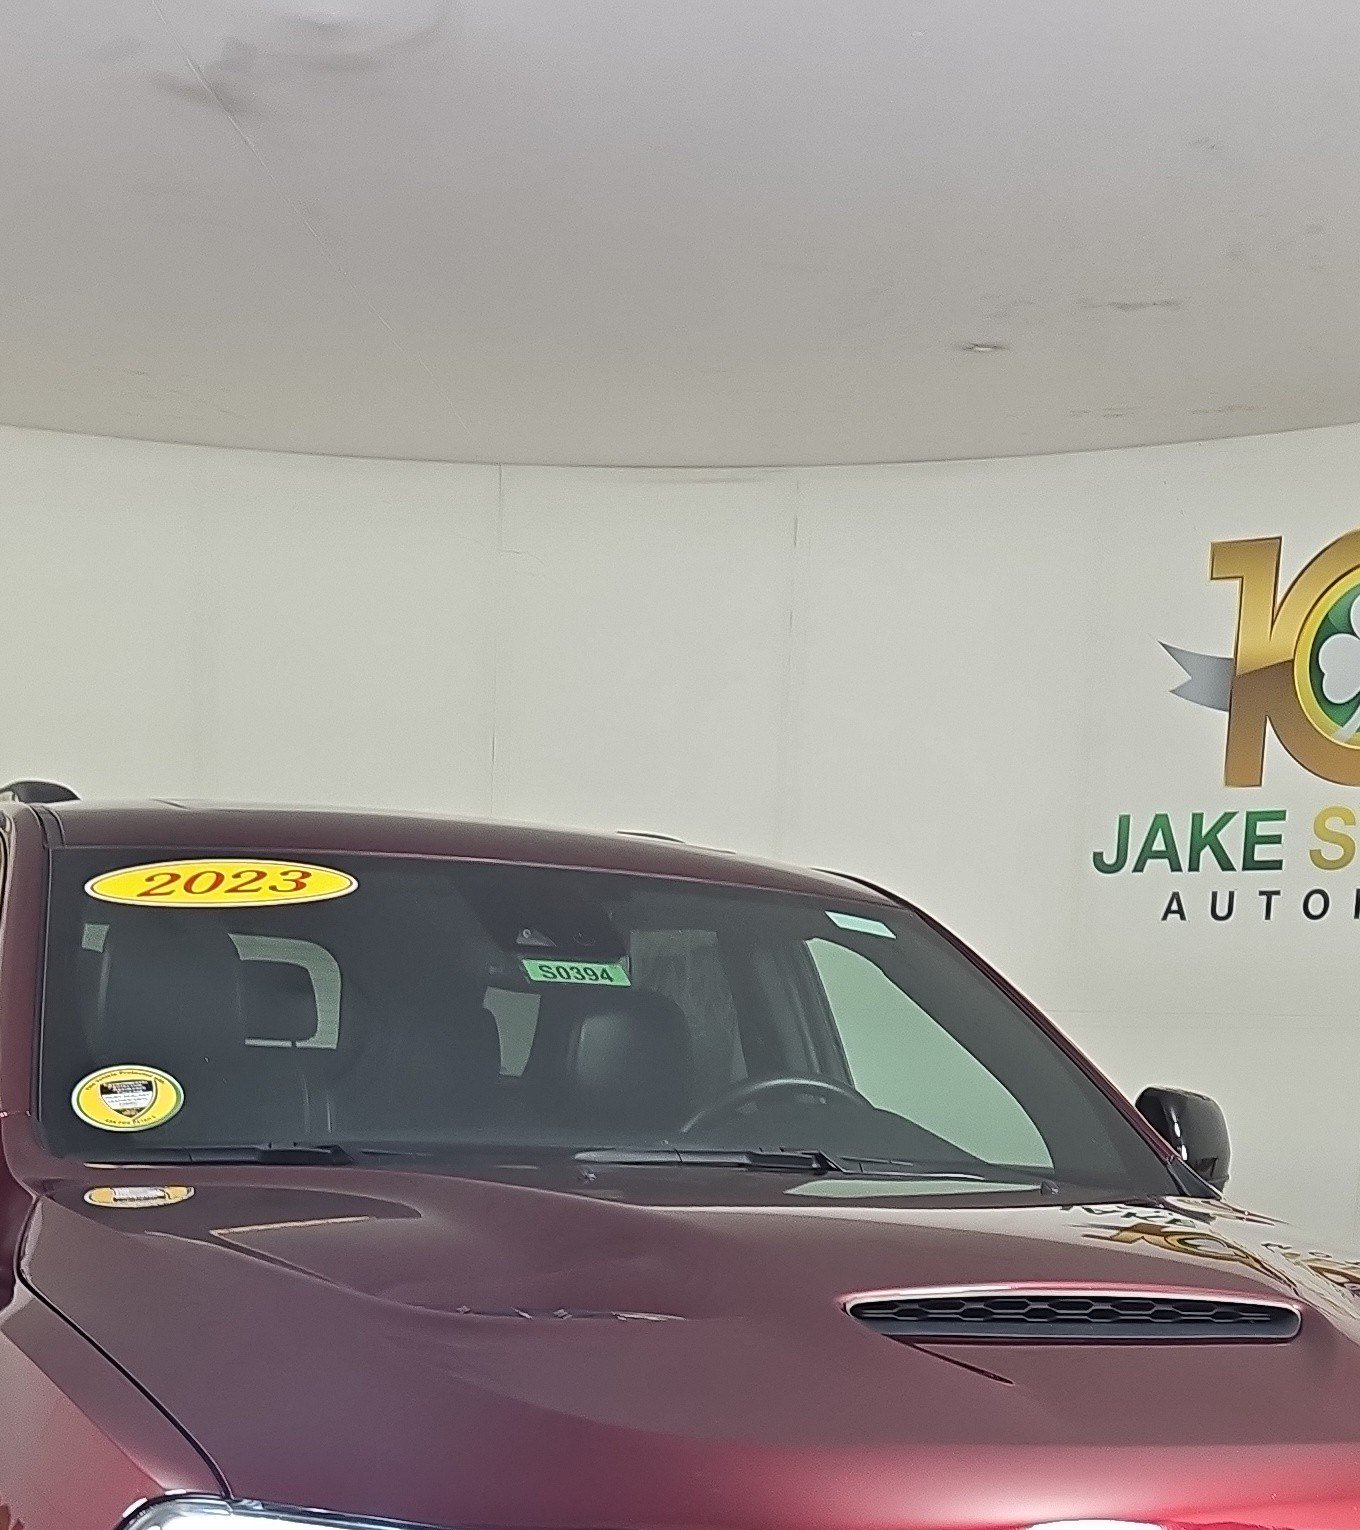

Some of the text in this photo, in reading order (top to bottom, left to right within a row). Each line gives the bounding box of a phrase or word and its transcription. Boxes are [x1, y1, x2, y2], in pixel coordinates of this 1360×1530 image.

[1093, 809, 1287, 874] JAKE
[136, 870, 312, 897] 2023
[538, 963, 614, 984] S0394
